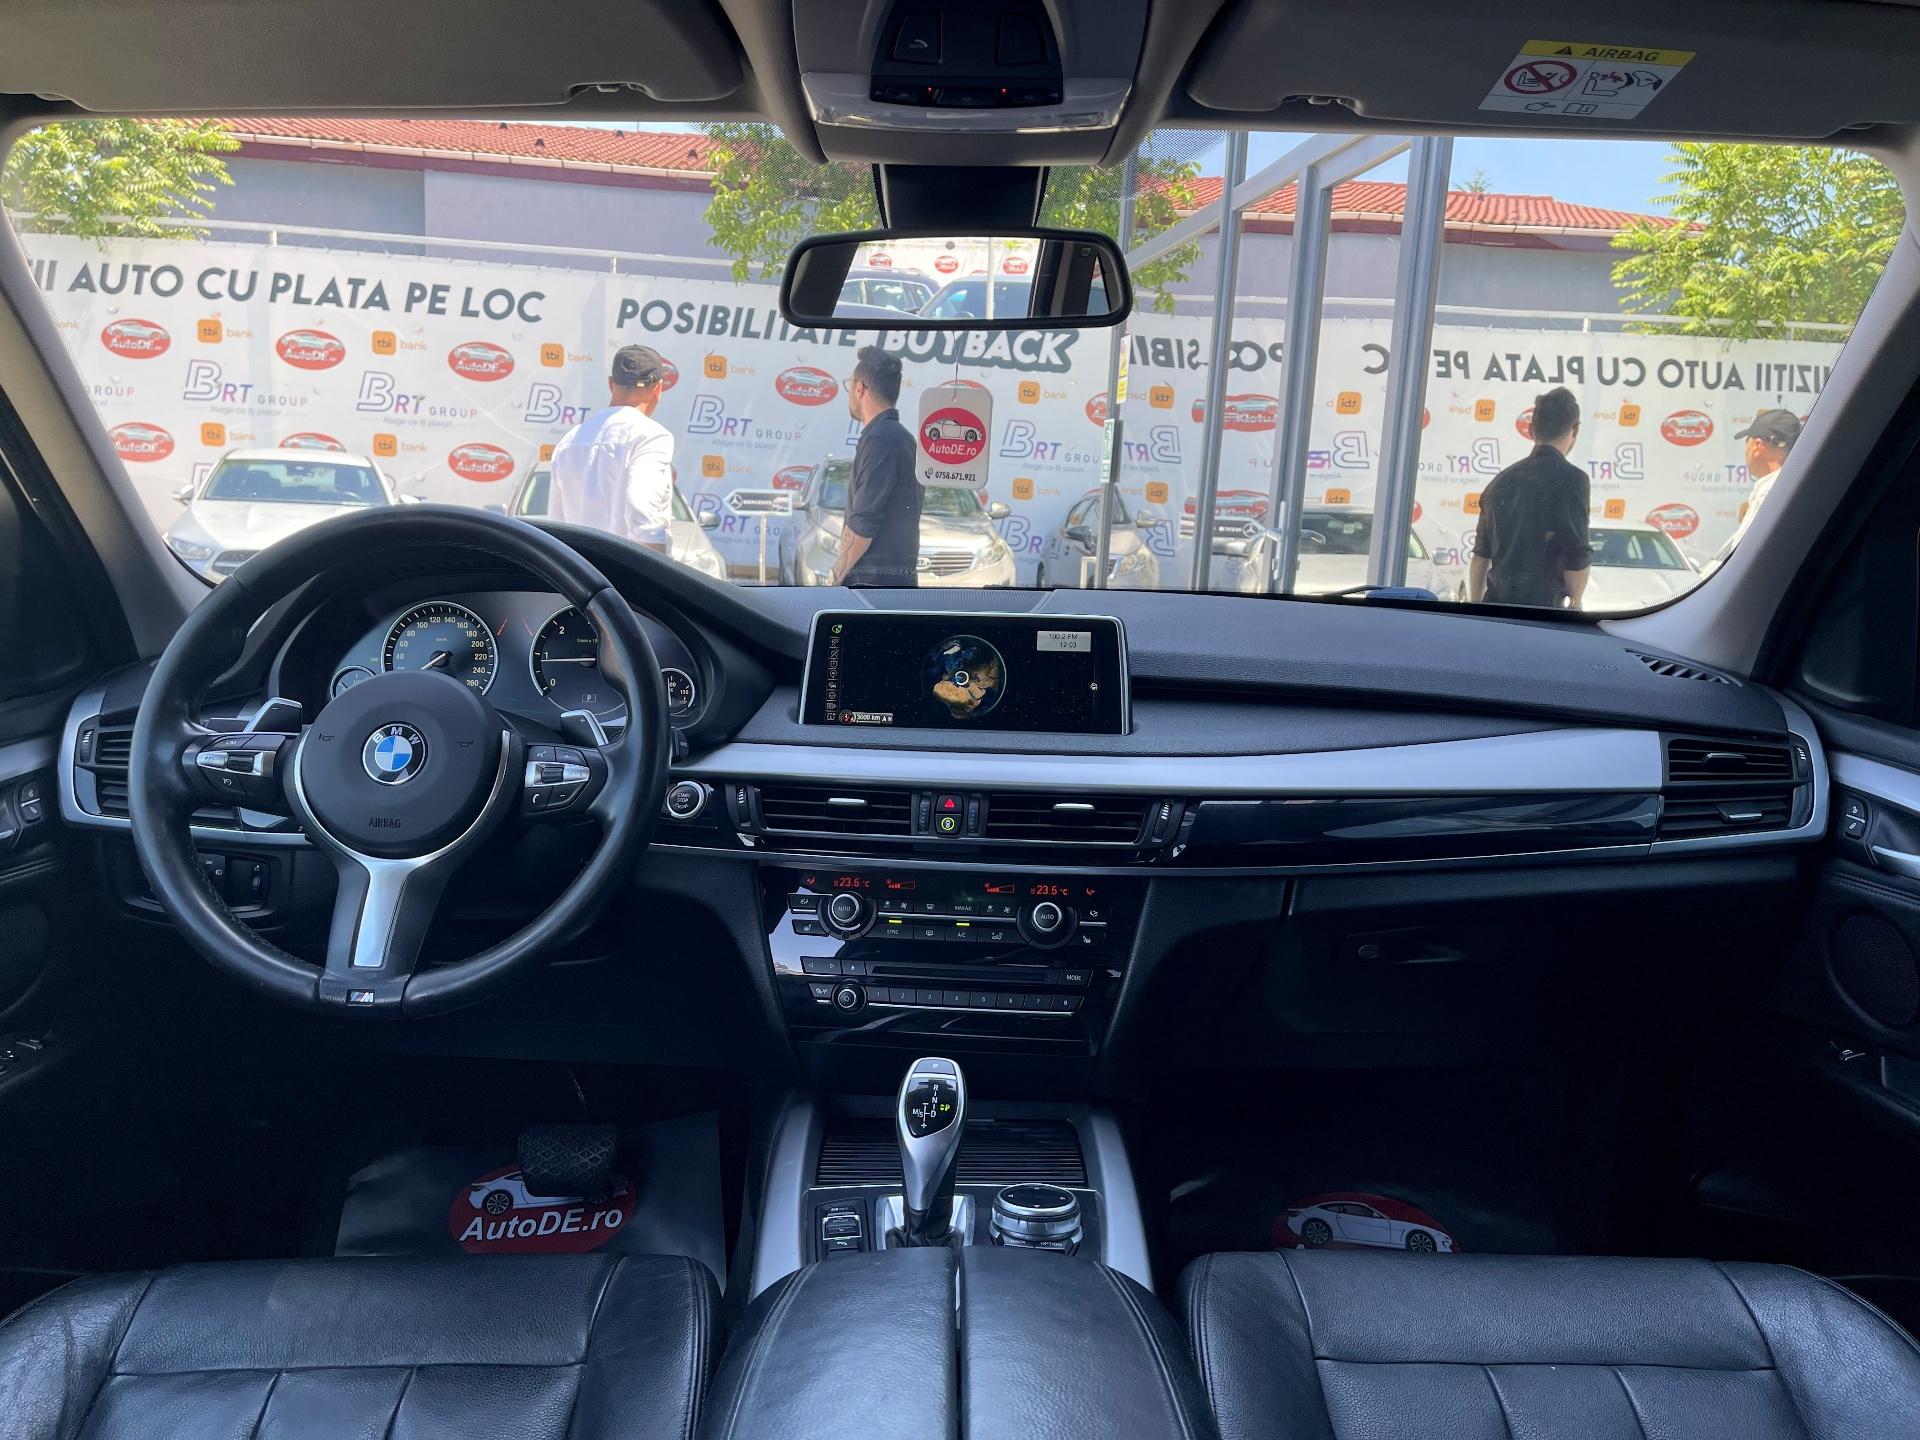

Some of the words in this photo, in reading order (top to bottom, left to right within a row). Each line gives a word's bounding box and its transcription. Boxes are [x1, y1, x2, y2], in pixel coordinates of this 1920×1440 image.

[1581, 46, 1659, 62] AIRBAG
[68, 261, 184, 298] AUTO
[197, 267, 258, 302] CU
[269, 272, 391, 312] PLATA
[404, 282, 451, 316] PE
[460, 286, 546, 324] LOC
[203, 327, 218, 338] tbi
[377, 339, 392, 349] tbi
[881, 329, 1073, 367] BUYBACK
[545, 351, 560, 361] tbi
[709, 362, 722, 372] tbi
[1022, 389, 1036, 398] tbi
[257, 394, 309, 407] GROUP
[429, 406, 478, 418] GROUP
[206, 430, 221, 440] tbi
[755, 428, 802, 441] GROUP
[378, 441, 393, 451] tbi
[928, 442, 977, 456] AutoDE.ro
[1064, 453, 1099, 464] GROU
[706, 462, 720, 472] tbi
[1016, 485, 1030, 494] tbi
[559, 625, 565, 635] 2
[550, 678, 556, 687] 0
[372, 726, 421, 745] BMW
[368, 817, 401, 829] AIRBAG
[931, 1096, 938, 1104] N
[930, 1110, 937, 1118] D
[458, 1206, 623, 1242] AutoDE.ro
